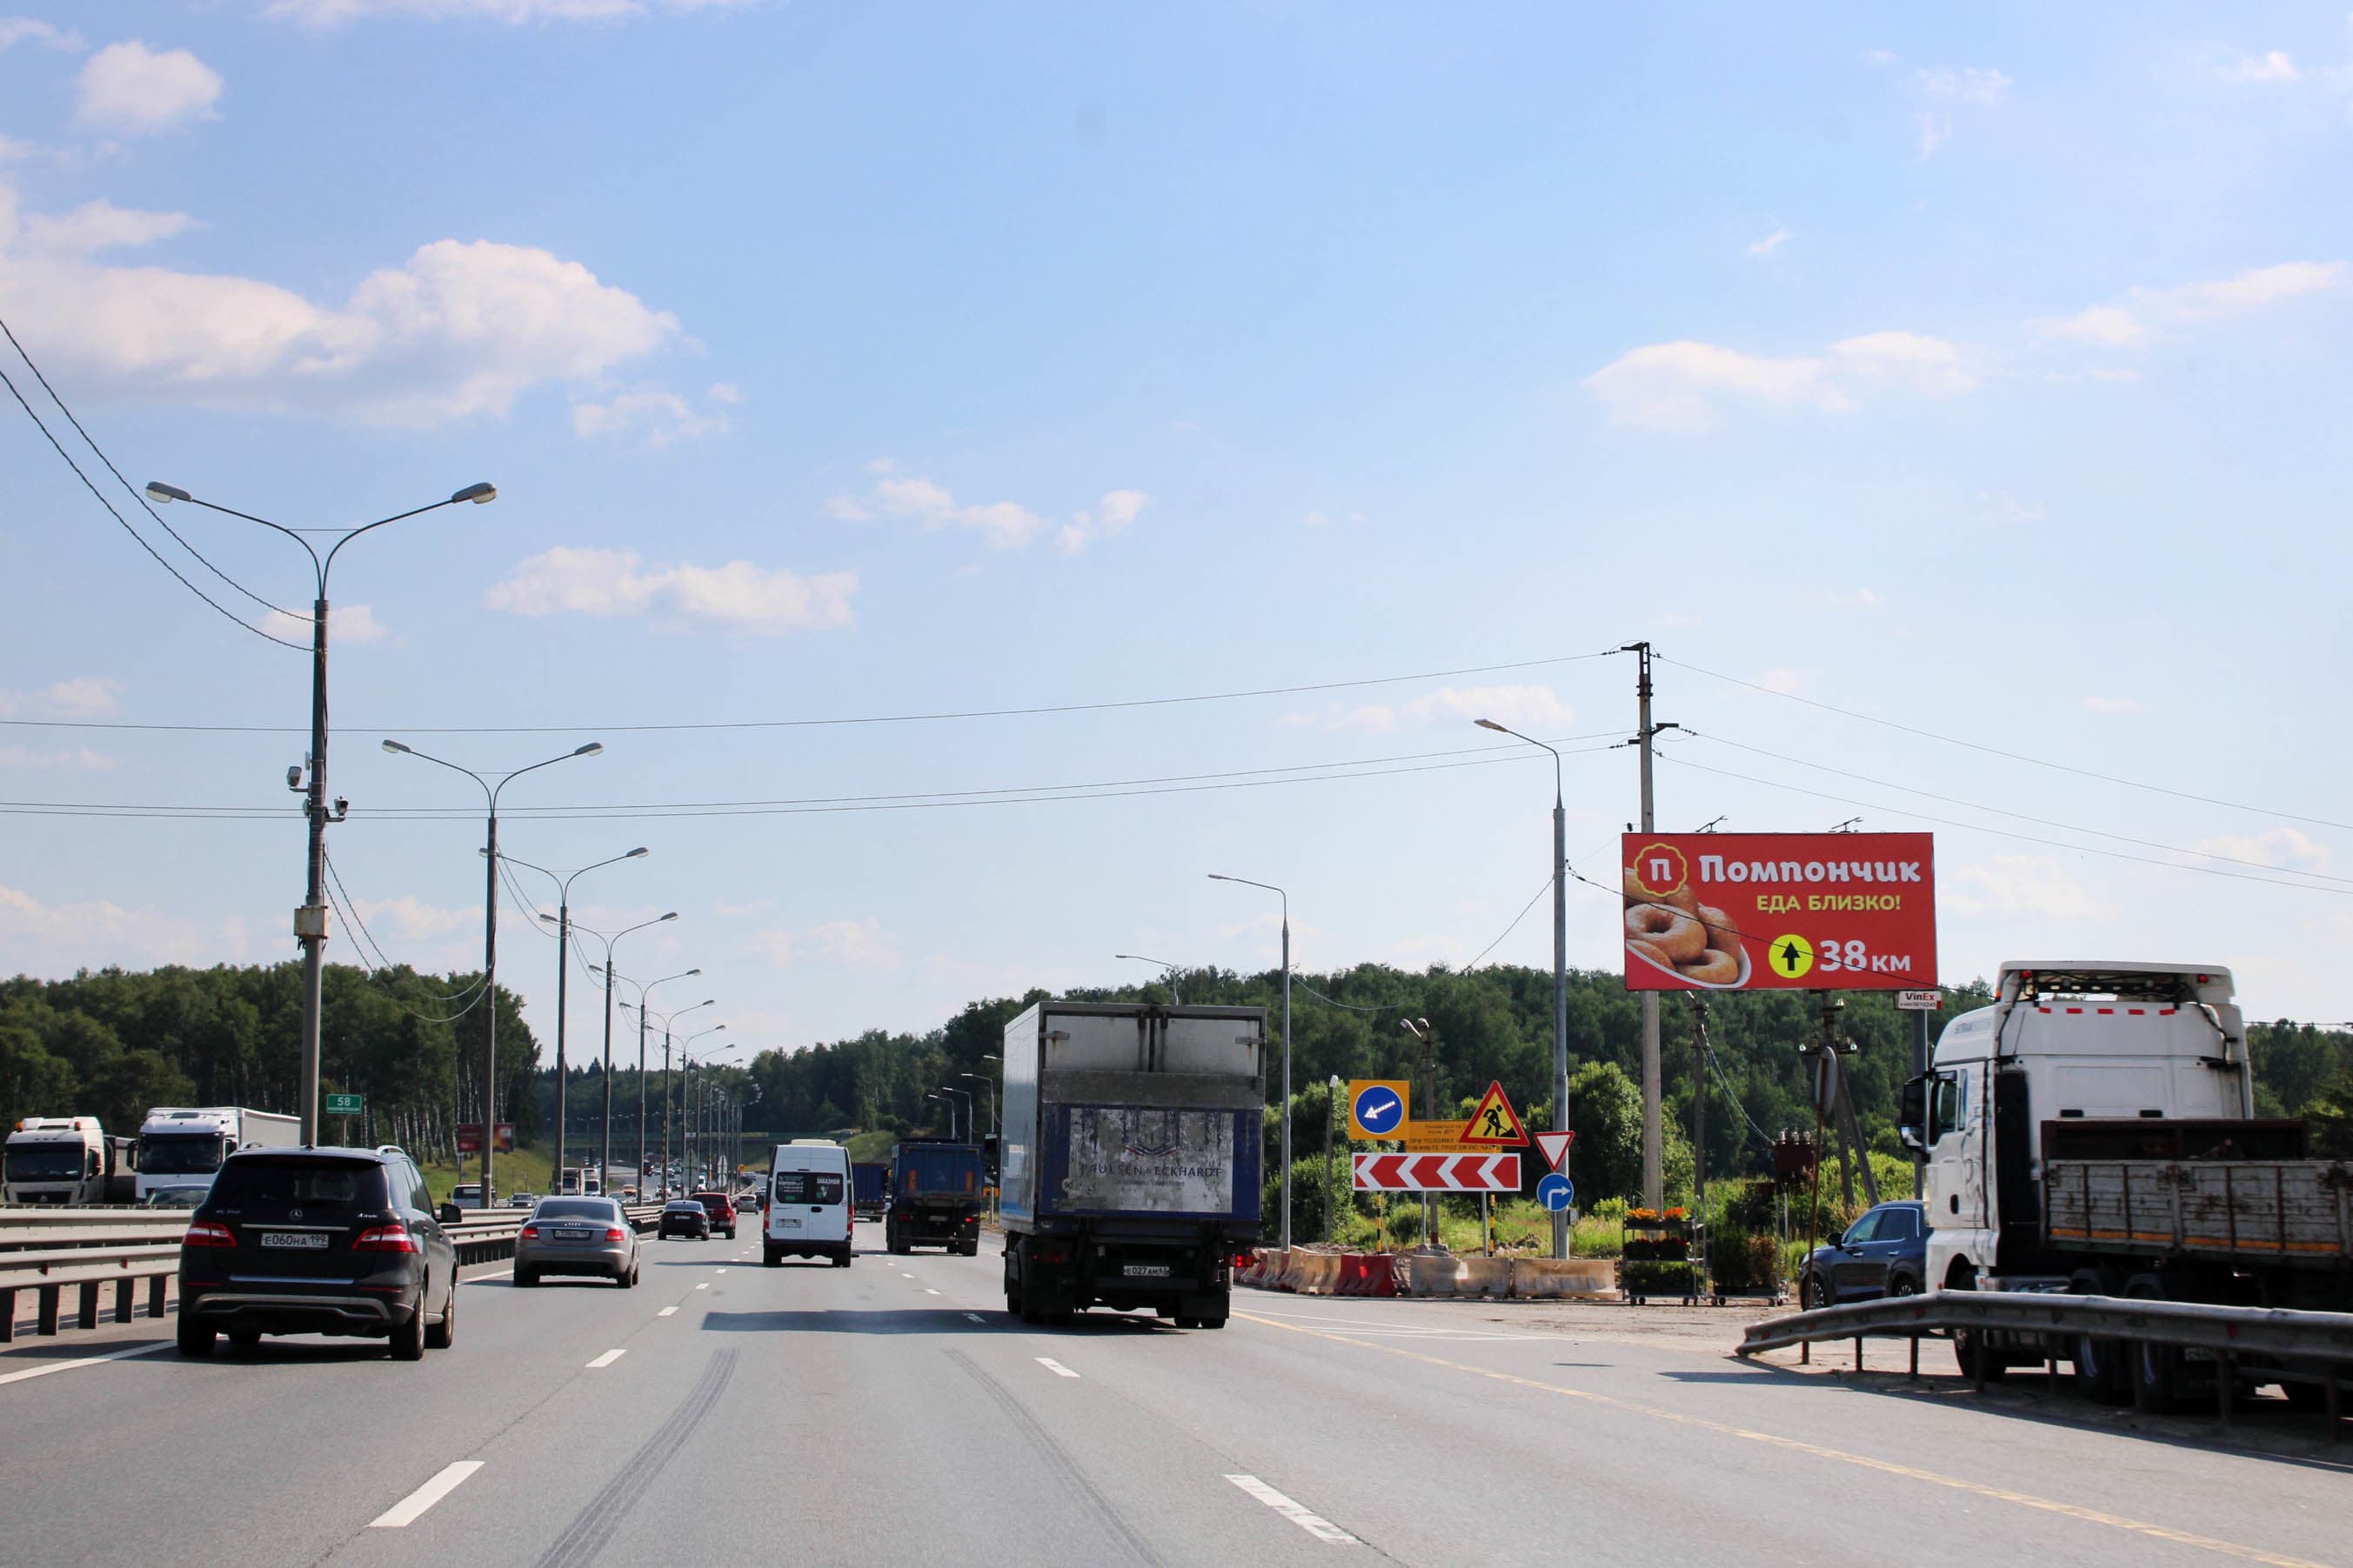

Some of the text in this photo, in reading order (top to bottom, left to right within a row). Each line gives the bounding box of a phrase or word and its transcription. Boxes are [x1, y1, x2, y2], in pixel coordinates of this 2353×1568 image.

[1699, 855, 1921, 883] Помпончик
[1756, 895, 1901, 914] ЕДА БЛИЗКО!
[1819, 940, 1868, 971] 38
[337, 1097, 351, 1107] 58
